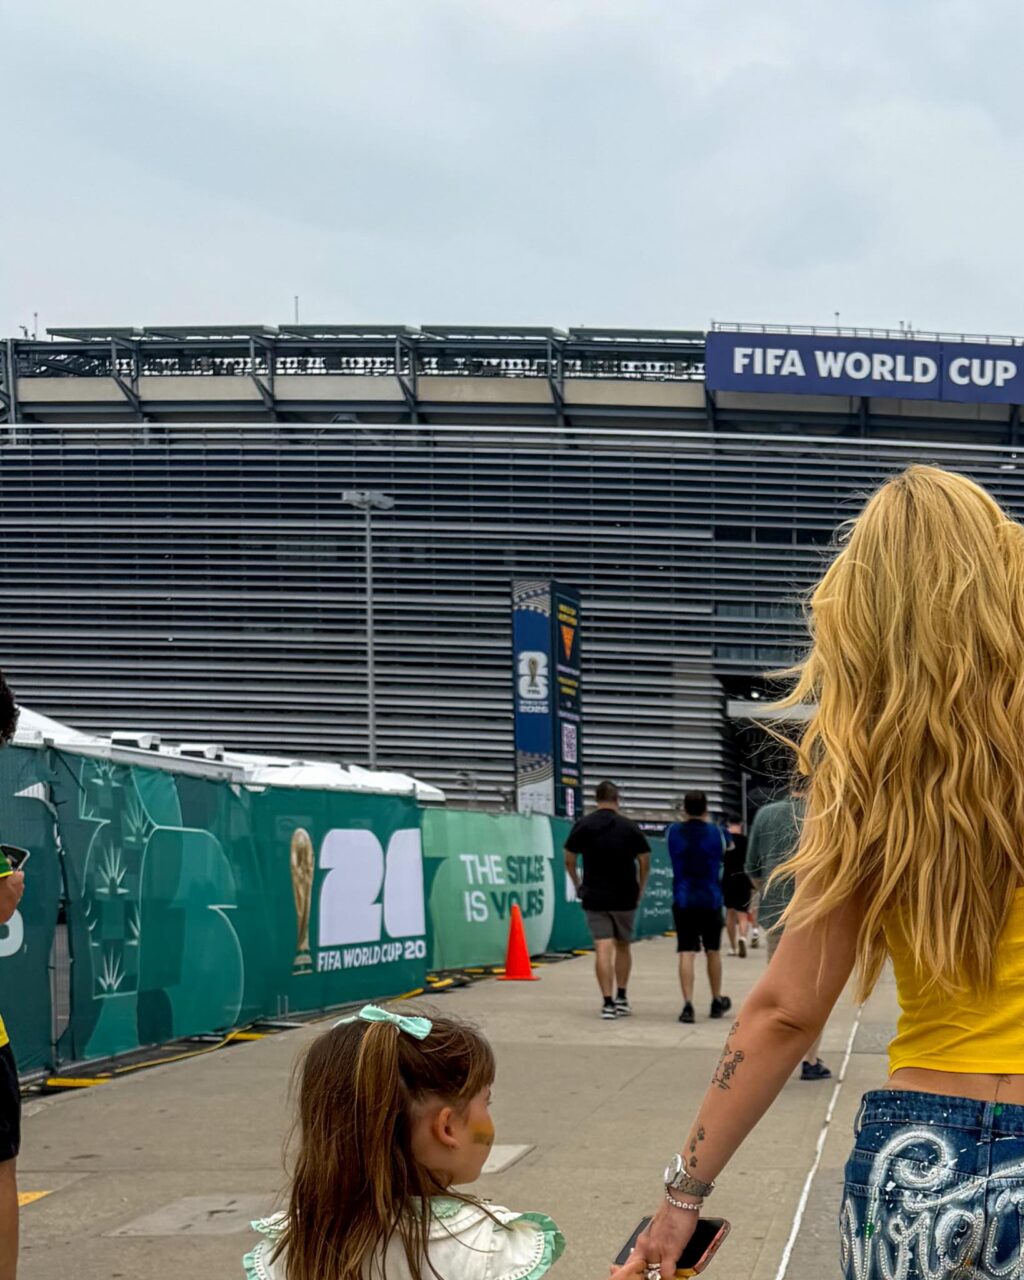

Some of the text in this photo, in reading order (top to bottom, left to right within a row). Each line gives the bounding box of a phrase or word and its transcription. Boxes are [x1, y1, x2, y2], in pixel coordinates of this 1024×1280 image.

[733, 347, 804, 376] FIFA
[814, 350, 938, 384] WORLD
[948, 357, 1018, 387] CUP
[459, 854, 506, 885] THE
[464, 890, 489, 922] IS
[317, 950, 341, 972] FIFA
[343, 945, 381, 968] WORLD
[381, 942, 403, 962] CUP
